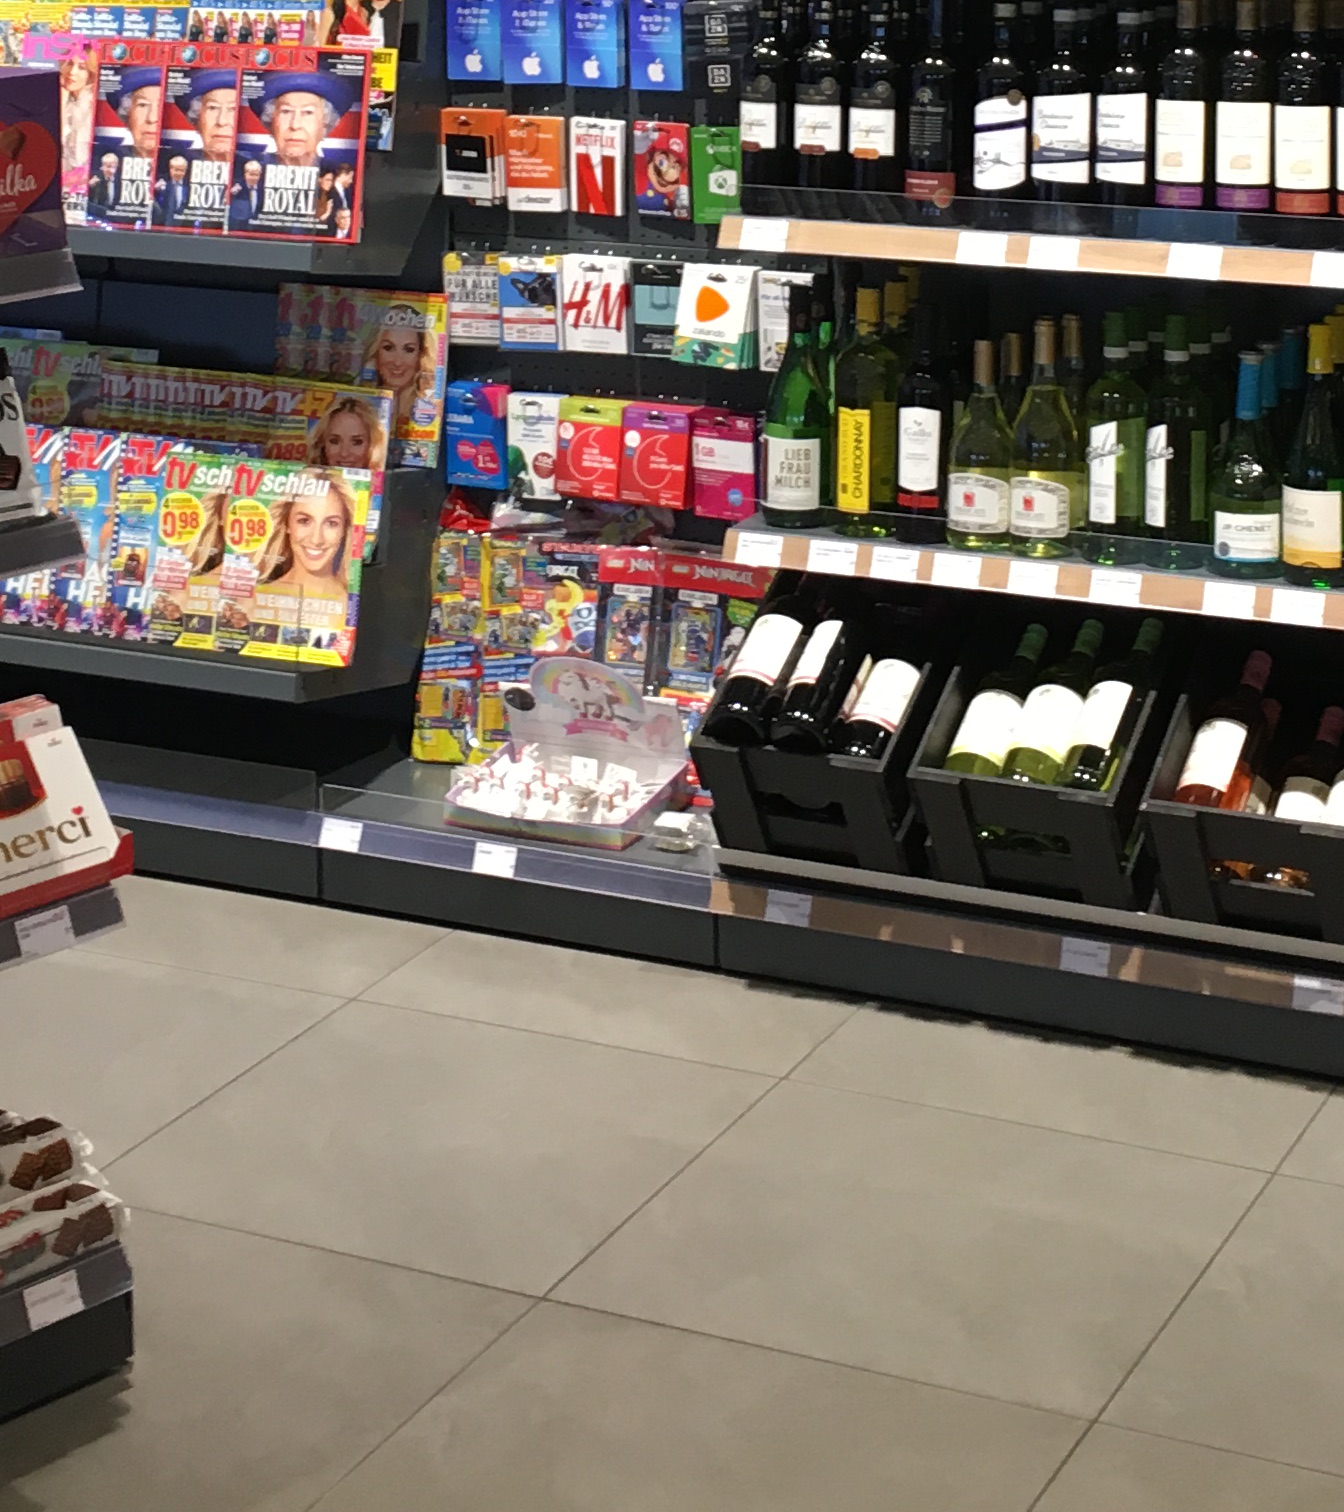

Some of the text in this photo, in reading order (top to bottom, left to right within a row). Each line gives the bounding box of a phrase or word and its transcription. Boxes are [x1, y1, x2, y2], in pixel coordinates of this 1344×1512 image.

[243, 47, 317, 68] FOCUS
[372, 51, 392, 65] HEIT
[575, 133, 616, 149] NETFLIX
[122, 156, 153, 180] BRE
[190, 160, 230, 184] BREX
[266, 164, 319, 190] BREXIT
[119, 180, 150, 204] ROY
[262, 189, 316, 214] ROYAL
[470, 278, 498, 290] ALLE
[562, 281, 632, 330] H&M
[783, 448, 812, 461] LIEB
[851, 419, 864, 499] CHARDONNAY
[164, 456, 198, 490] tv
[232, 463, 331, 497] tv schlau
[779, 461, 812, 475] FRAU
[775, 475, 812, 489] MILCH
